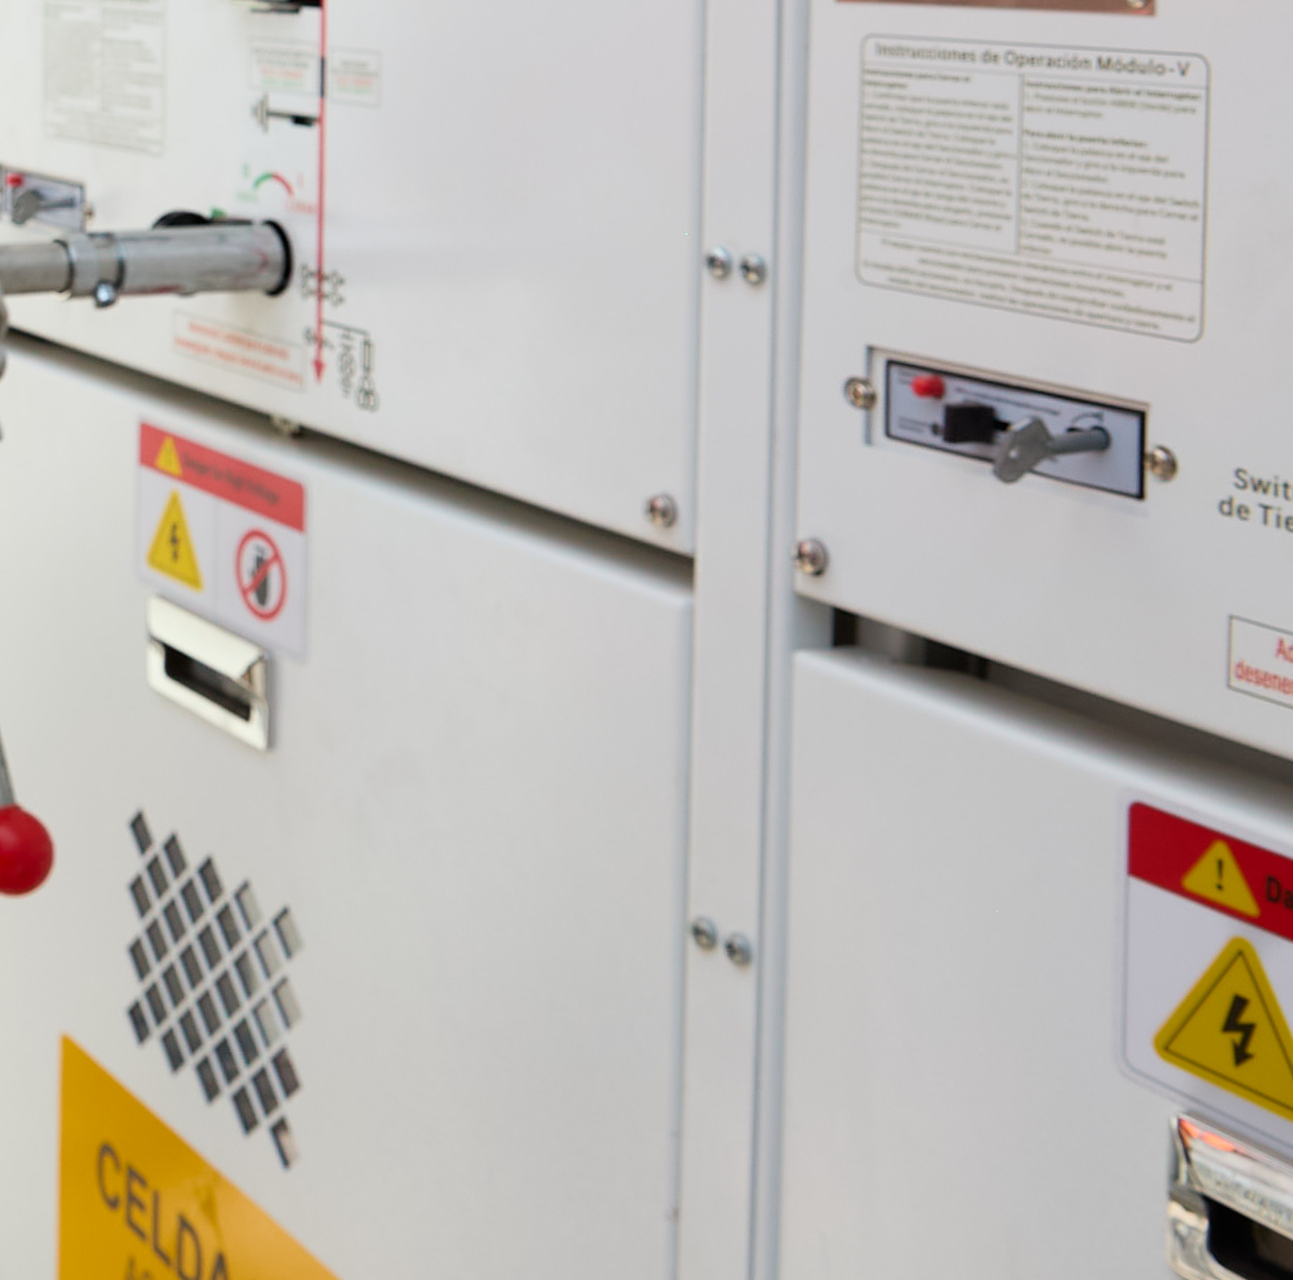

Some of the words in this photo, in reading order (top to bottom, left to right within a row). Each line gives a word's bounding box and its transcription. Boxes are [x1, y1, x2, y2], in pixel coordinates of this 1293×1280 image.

[874, 42, 977, 63] Instrucciones
[981, 48, 1000, 64] de
[1004, 50, 1094, 70] Operación
[1217, 495, 1251, 521] de
